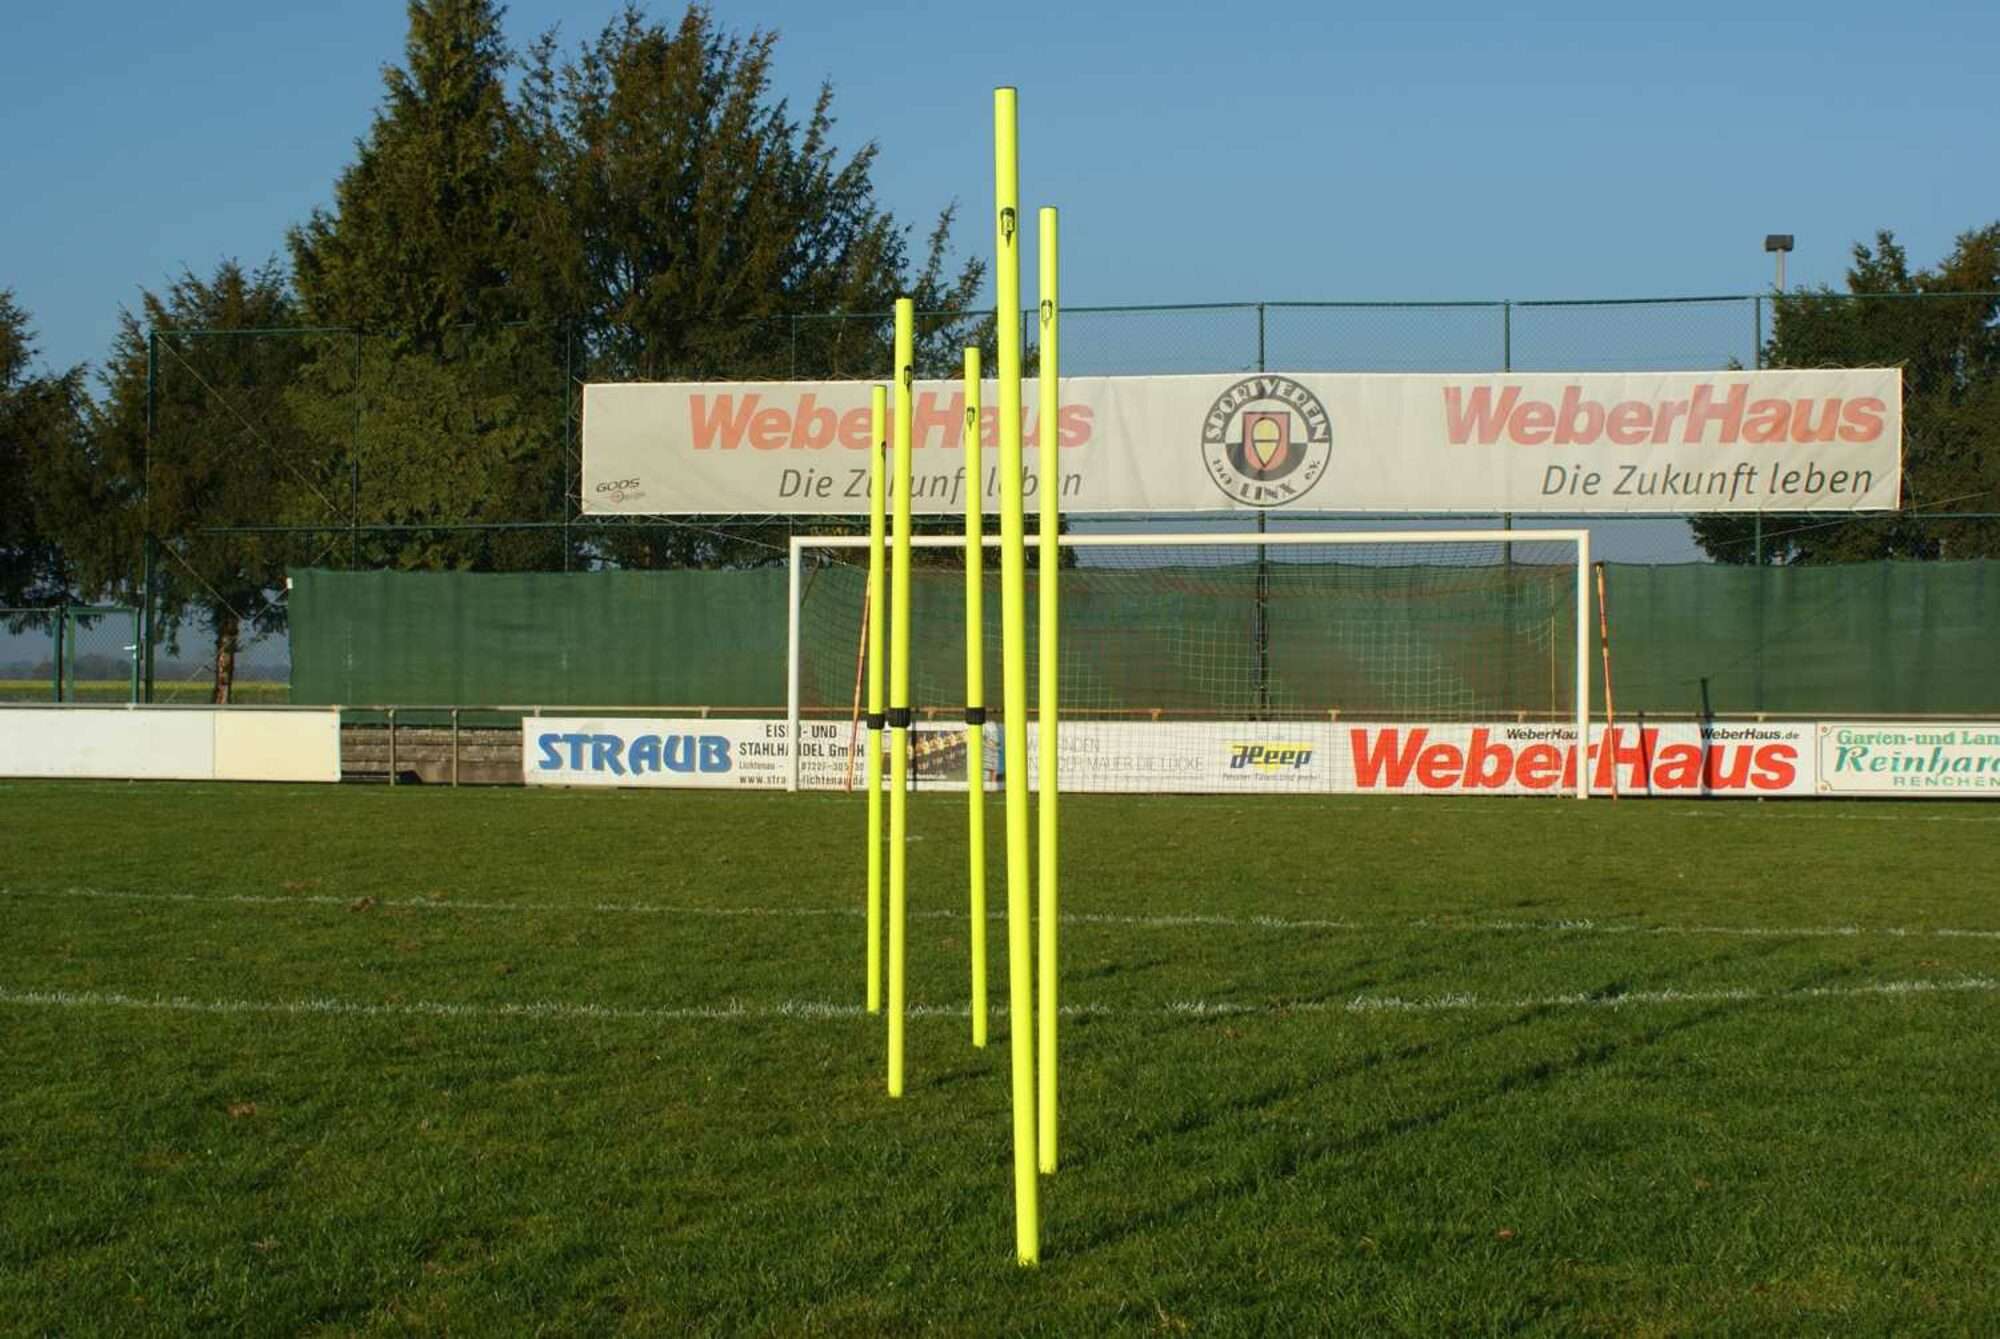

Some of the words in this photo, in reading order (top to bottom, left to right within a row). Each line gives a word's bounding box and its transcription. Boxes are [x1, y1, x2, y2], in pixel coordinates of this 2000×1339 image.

[690, 392, 1095, 451] WebeHaus
[1205, 377, 1329, 441] SPORTVEREIN
[1443, 383, 1887, 446] WeberHaus
[780, 468, 833, 498] Die
[844, 466, 977, 505] Zunf
[986, 466, 1082, 498] lbn
[1240, 483, 1297, 501] LINX
[1541, 465, 1602, 496] Die
[1613, 462, 1759, 501] Zukunft
[1769, 462, 1873, 494] leben
[739, 742, 825, 757] STAHLHDEL
[828, 743, 865, 757] GmH
[811, 724, 837, 738] UND
[1507, 728, 1587, 739] WeberHau
[1700, 727, 1800, 740] WeberHaus.de
[1837, 730, 1955, 745] Garten-und
[537, 732, 734, 777] STRAUB
[1349, 727, 1799, 791] WeberHaus
